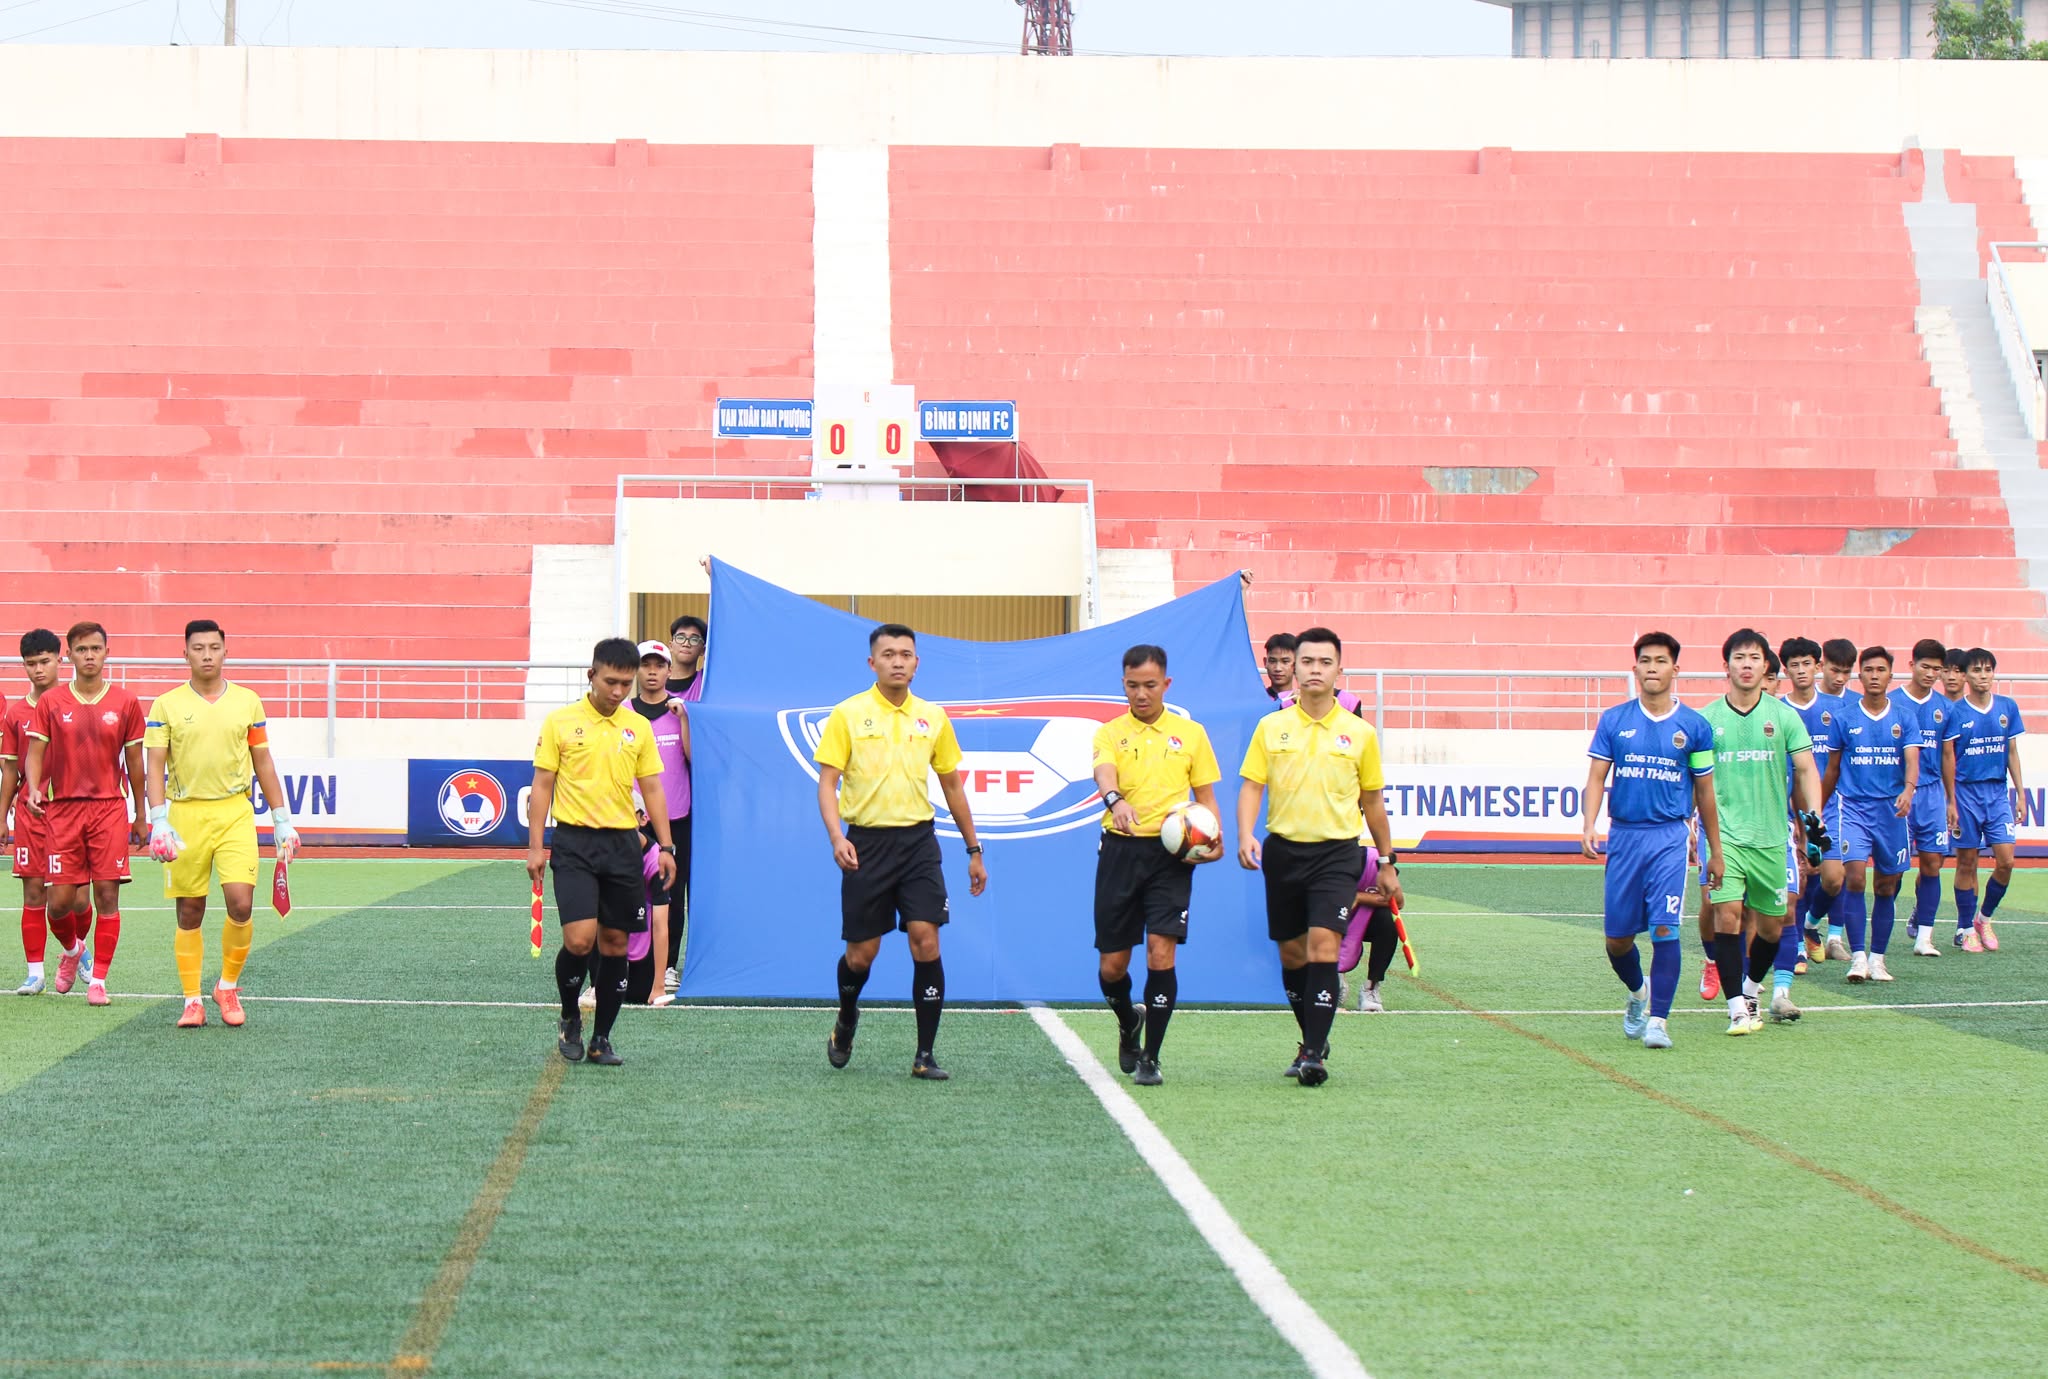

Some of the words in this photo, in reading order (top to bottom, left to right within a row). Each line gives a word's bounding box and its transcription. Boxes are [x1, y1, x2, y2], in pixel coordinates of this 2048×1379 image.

[738, 404, 760, 428] XUÂN
[924, 407, 957, 431] BÌNH
[958, 410, 990, 434] ĐỊNH
[993, 410, 1009, 431] FC
[830, 423, 845, 455] 0
[886, 423, 901, 455] 0
[1625, 752, 1646, 763] CÔNG
[1647, 754, 1656, 763] TY
[1736, 750, 1776, 762] SPORT
[1850, 756, 1873, 765] MINH
[1875, 754, 1900, 765] THÀN
[1615, 766, 1644, 778] MINH
[1646, 766, 1681, 782] THÀNH
[463, 817, 481, 825] VFF
[16, 847, 29, 866] 13
[48, 854, 62, 874] 15
[1896, 847, 1907, 866] 77
[1665, 894, 1680, 914] 12
